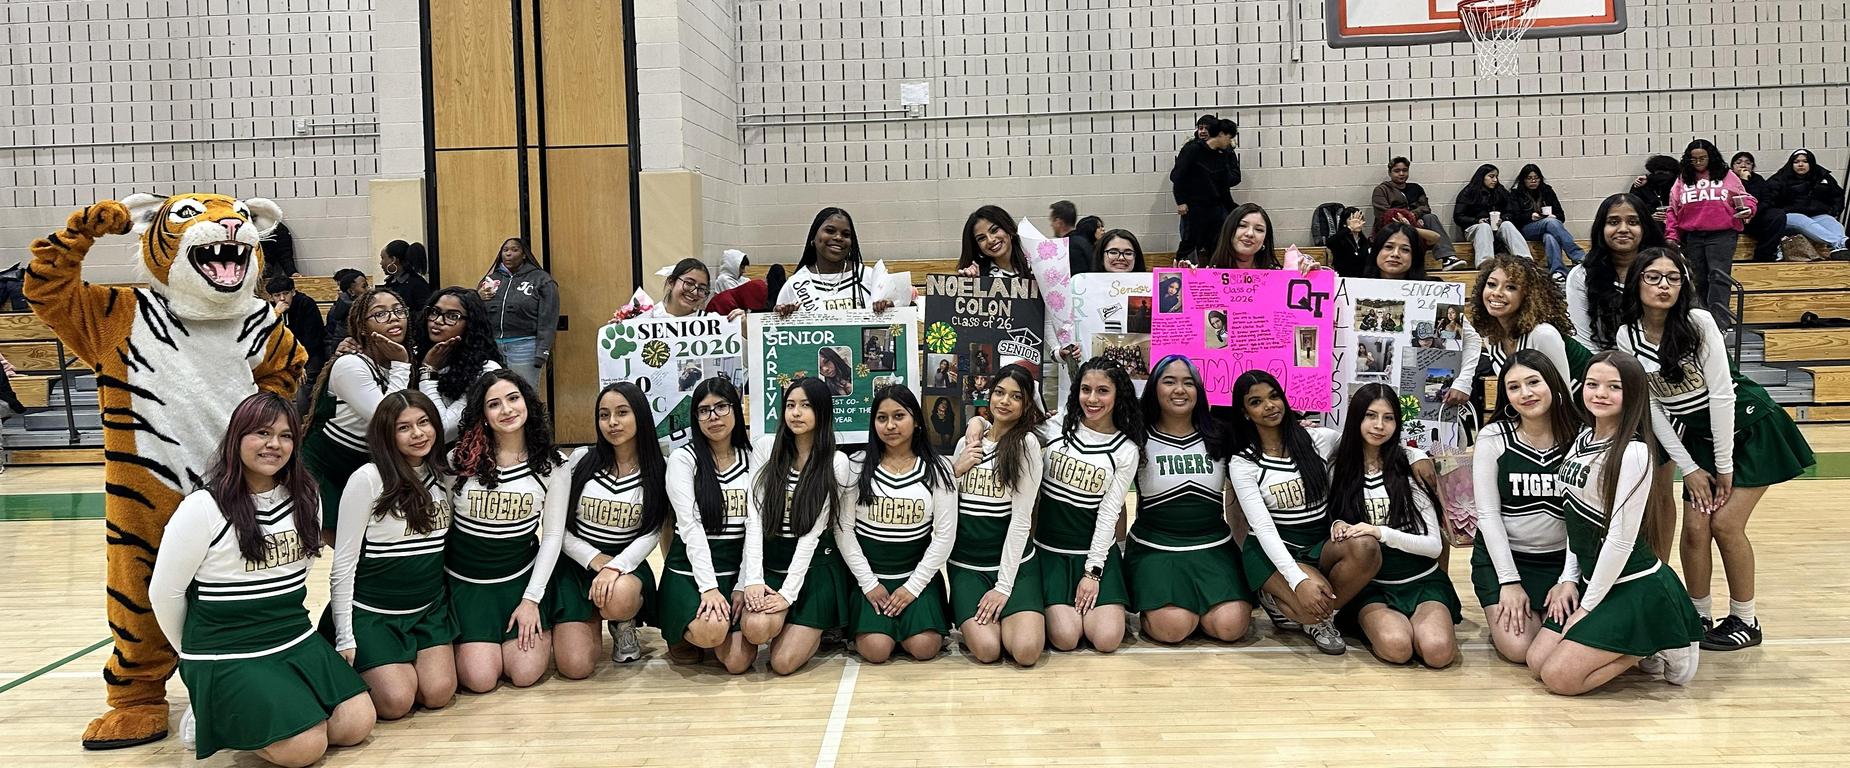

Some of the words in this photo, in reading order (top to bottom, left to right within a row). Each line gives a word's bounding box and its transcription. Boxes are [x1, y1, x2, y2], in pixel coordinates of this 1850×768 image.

[793, 280, 820, 312] Senio
[926, 274, 1038, 299] NOELANI
[1109, 280, 1151, 298] Senior
[1401, 283, 1450, 298] SENIOR
[955, 297, 1012, 317] COLON
[1230, 295, 1254, 303] 2026
[1287, 279, 1329, 318] QT
[637, 319, 722, 340] SENIOR
[982, 315, 995, 328] of
[675, 332, 741, 358] 2026
[766, 331, 835, 346] SENIOR
[999, 342, 1039, 363] SENIOR
[858, 406, 872, 414] THE
[1050, 451, 1106, 493] TIGERS
[1155, 453, 1214, 476] TIGERS
[468, 489, 533, 521] TIGERS
[580, 495, 643, 528] TIGERS
[867, 496, 925, 525] TIGERS
